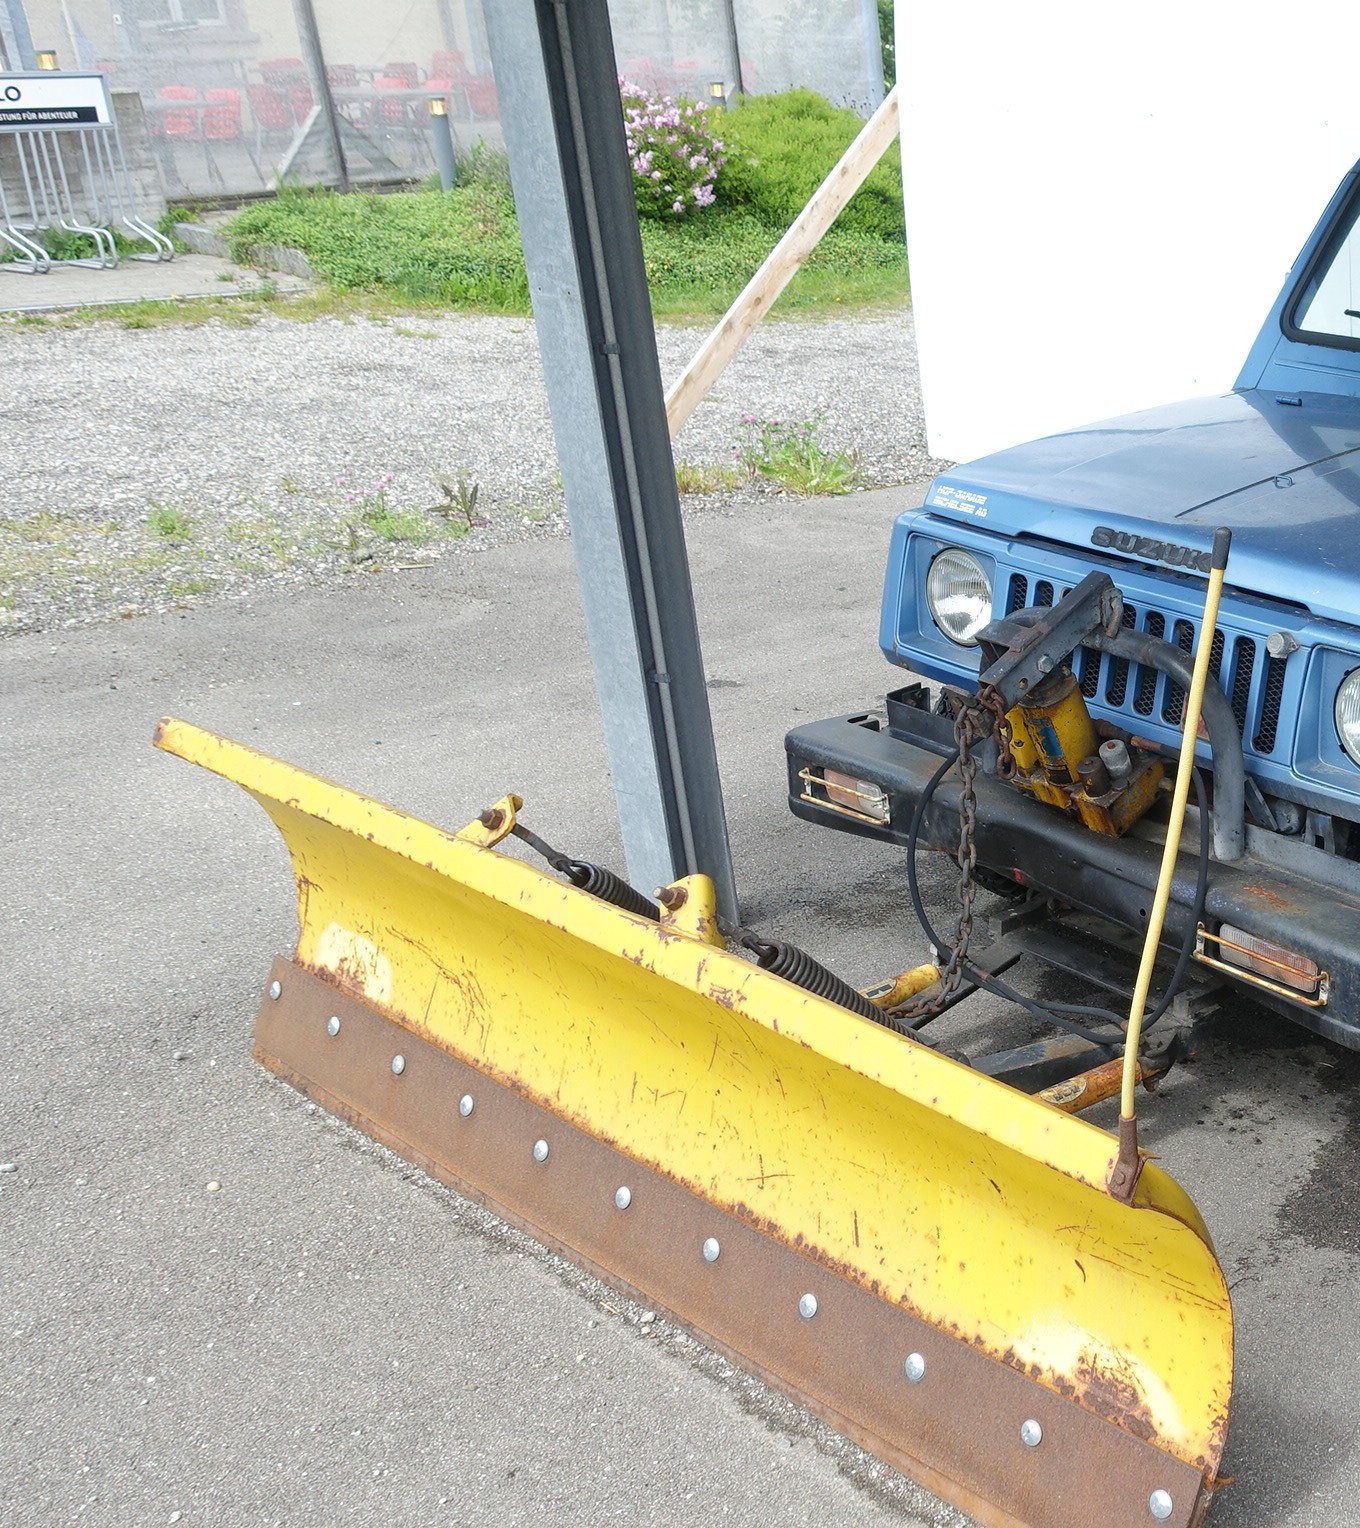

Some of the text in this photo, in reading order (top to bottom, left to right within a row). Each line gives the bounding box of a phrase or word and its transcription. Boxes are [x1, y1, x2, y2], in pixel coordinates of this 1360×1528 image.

[0, 86, 21, 101] O
[22, 111, 37, 120] FÜR
[38, 111, 79, 120] ABENTEUER
[1090, 526, 1213, 573] SUZUK
